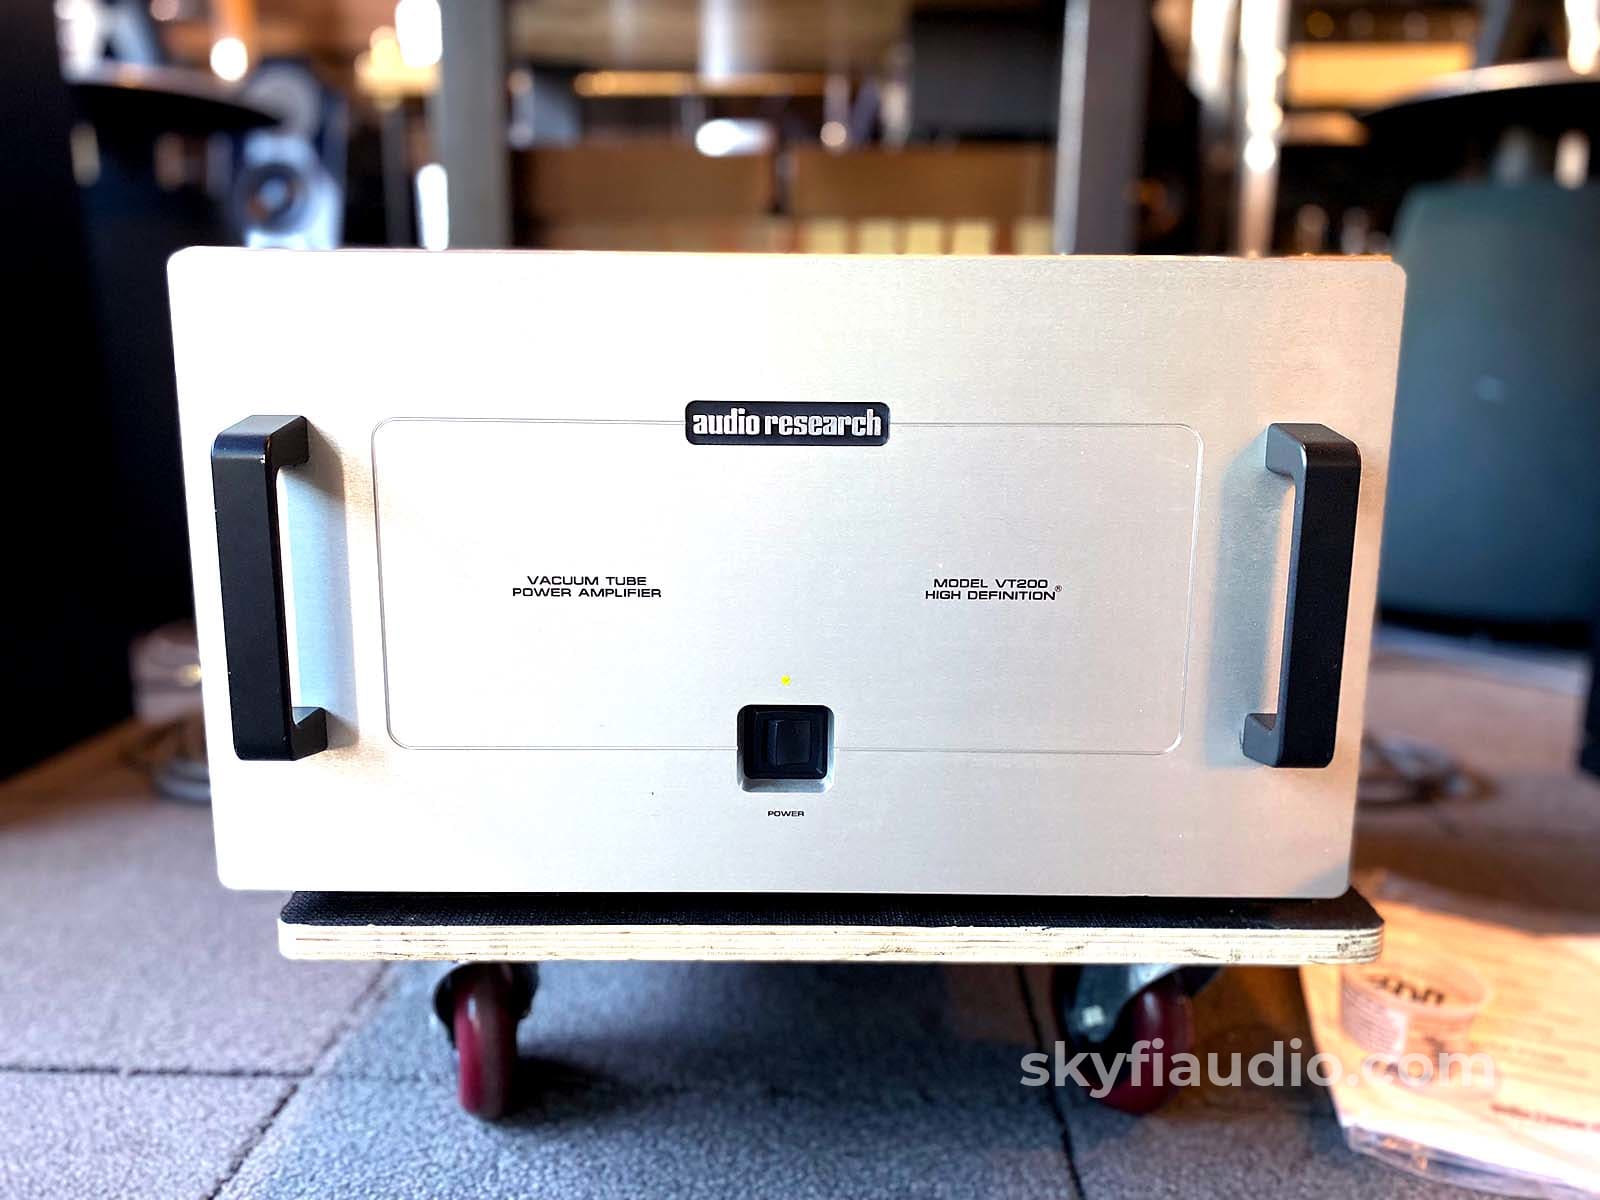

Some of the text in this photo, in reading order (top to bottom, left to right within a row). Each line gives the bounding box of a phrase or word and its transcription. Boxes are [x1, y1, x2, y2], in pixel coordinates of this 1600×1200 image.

[692, 407, 882, 436] audio research
[527, 575, 647, 586] VACUUM TUBE
[933, 578, 1048, 589] MODEL VT200
[512, 587, 662, 598] POWER AMPLIFIER
[925, 590, 961, 600] HIGH
